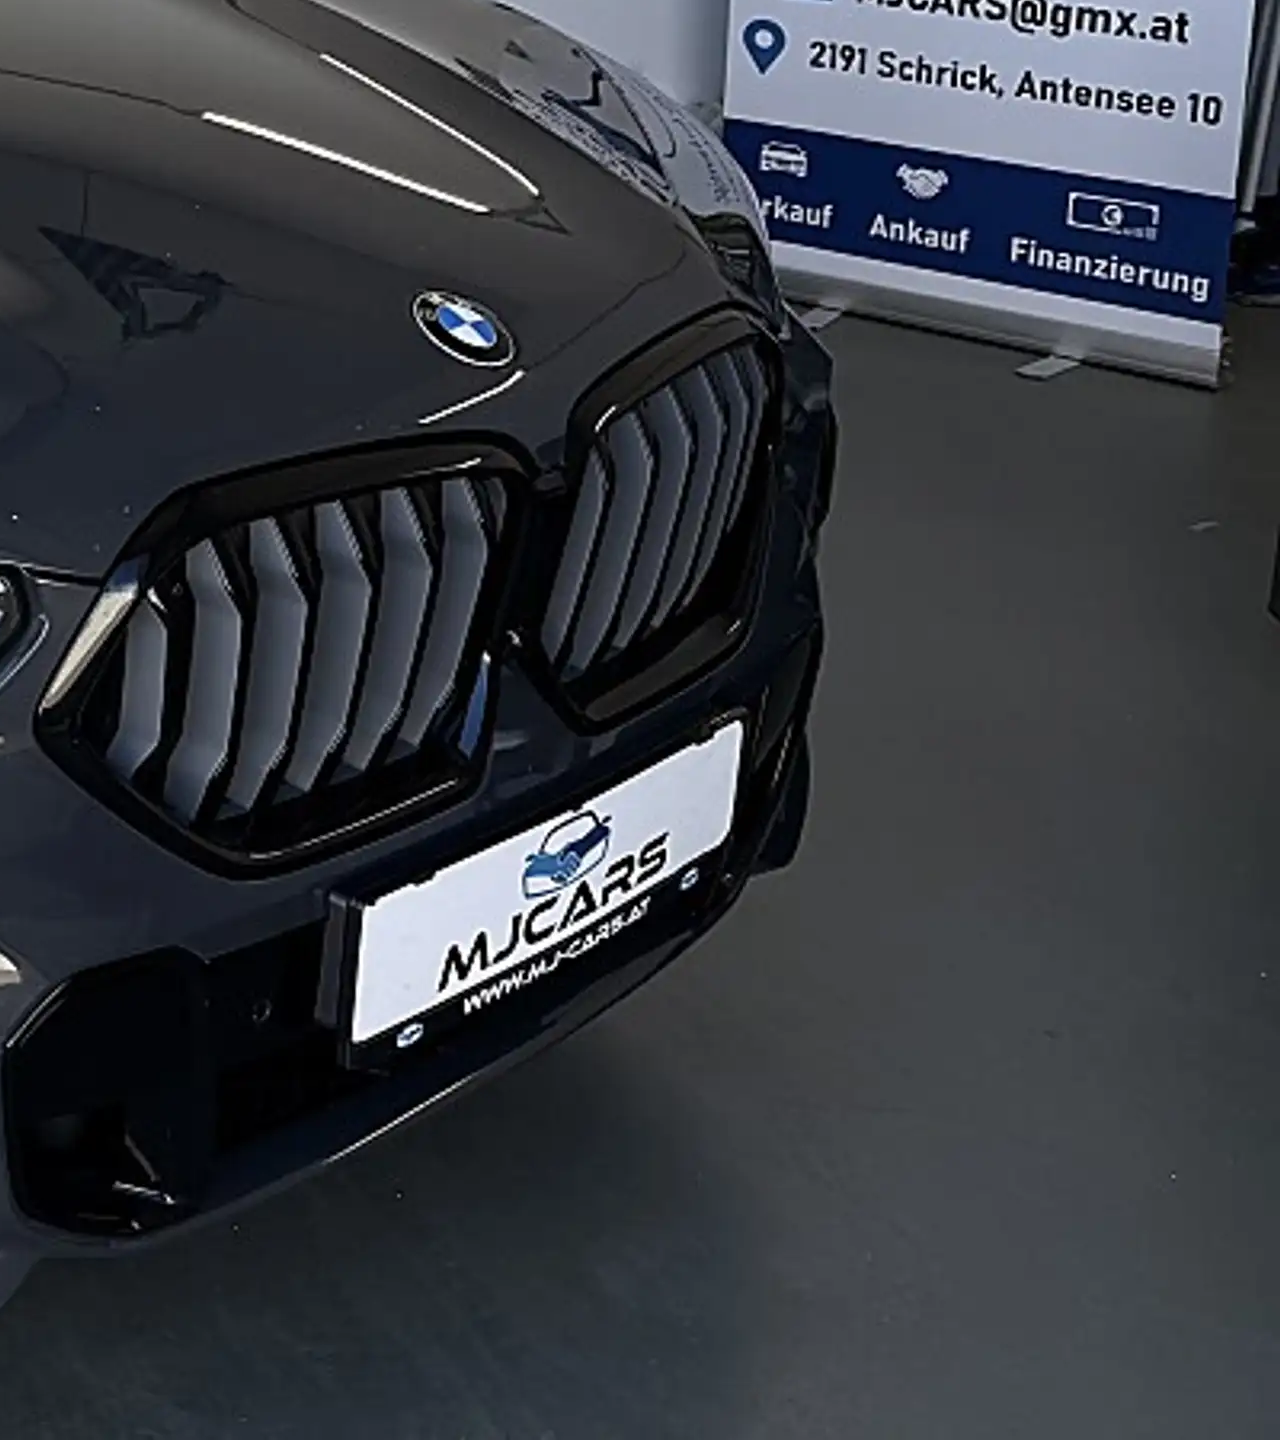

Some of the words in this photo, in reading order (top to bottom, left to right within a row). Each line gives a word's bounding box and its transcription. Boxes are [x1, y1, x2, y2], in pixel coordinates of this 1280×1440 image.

[809, 40, 867, 73] 2191
[876, 50, 1005, 100] Schrick,
[1014, 70, 1176, 120] Antensee
[1187, 93, 1223, 126] 10
[869, 213, 970, 254] Ankauf
[1009, 235, 1210, 303] Finanzierung
[437, 830, 670, 994] MJCARS
